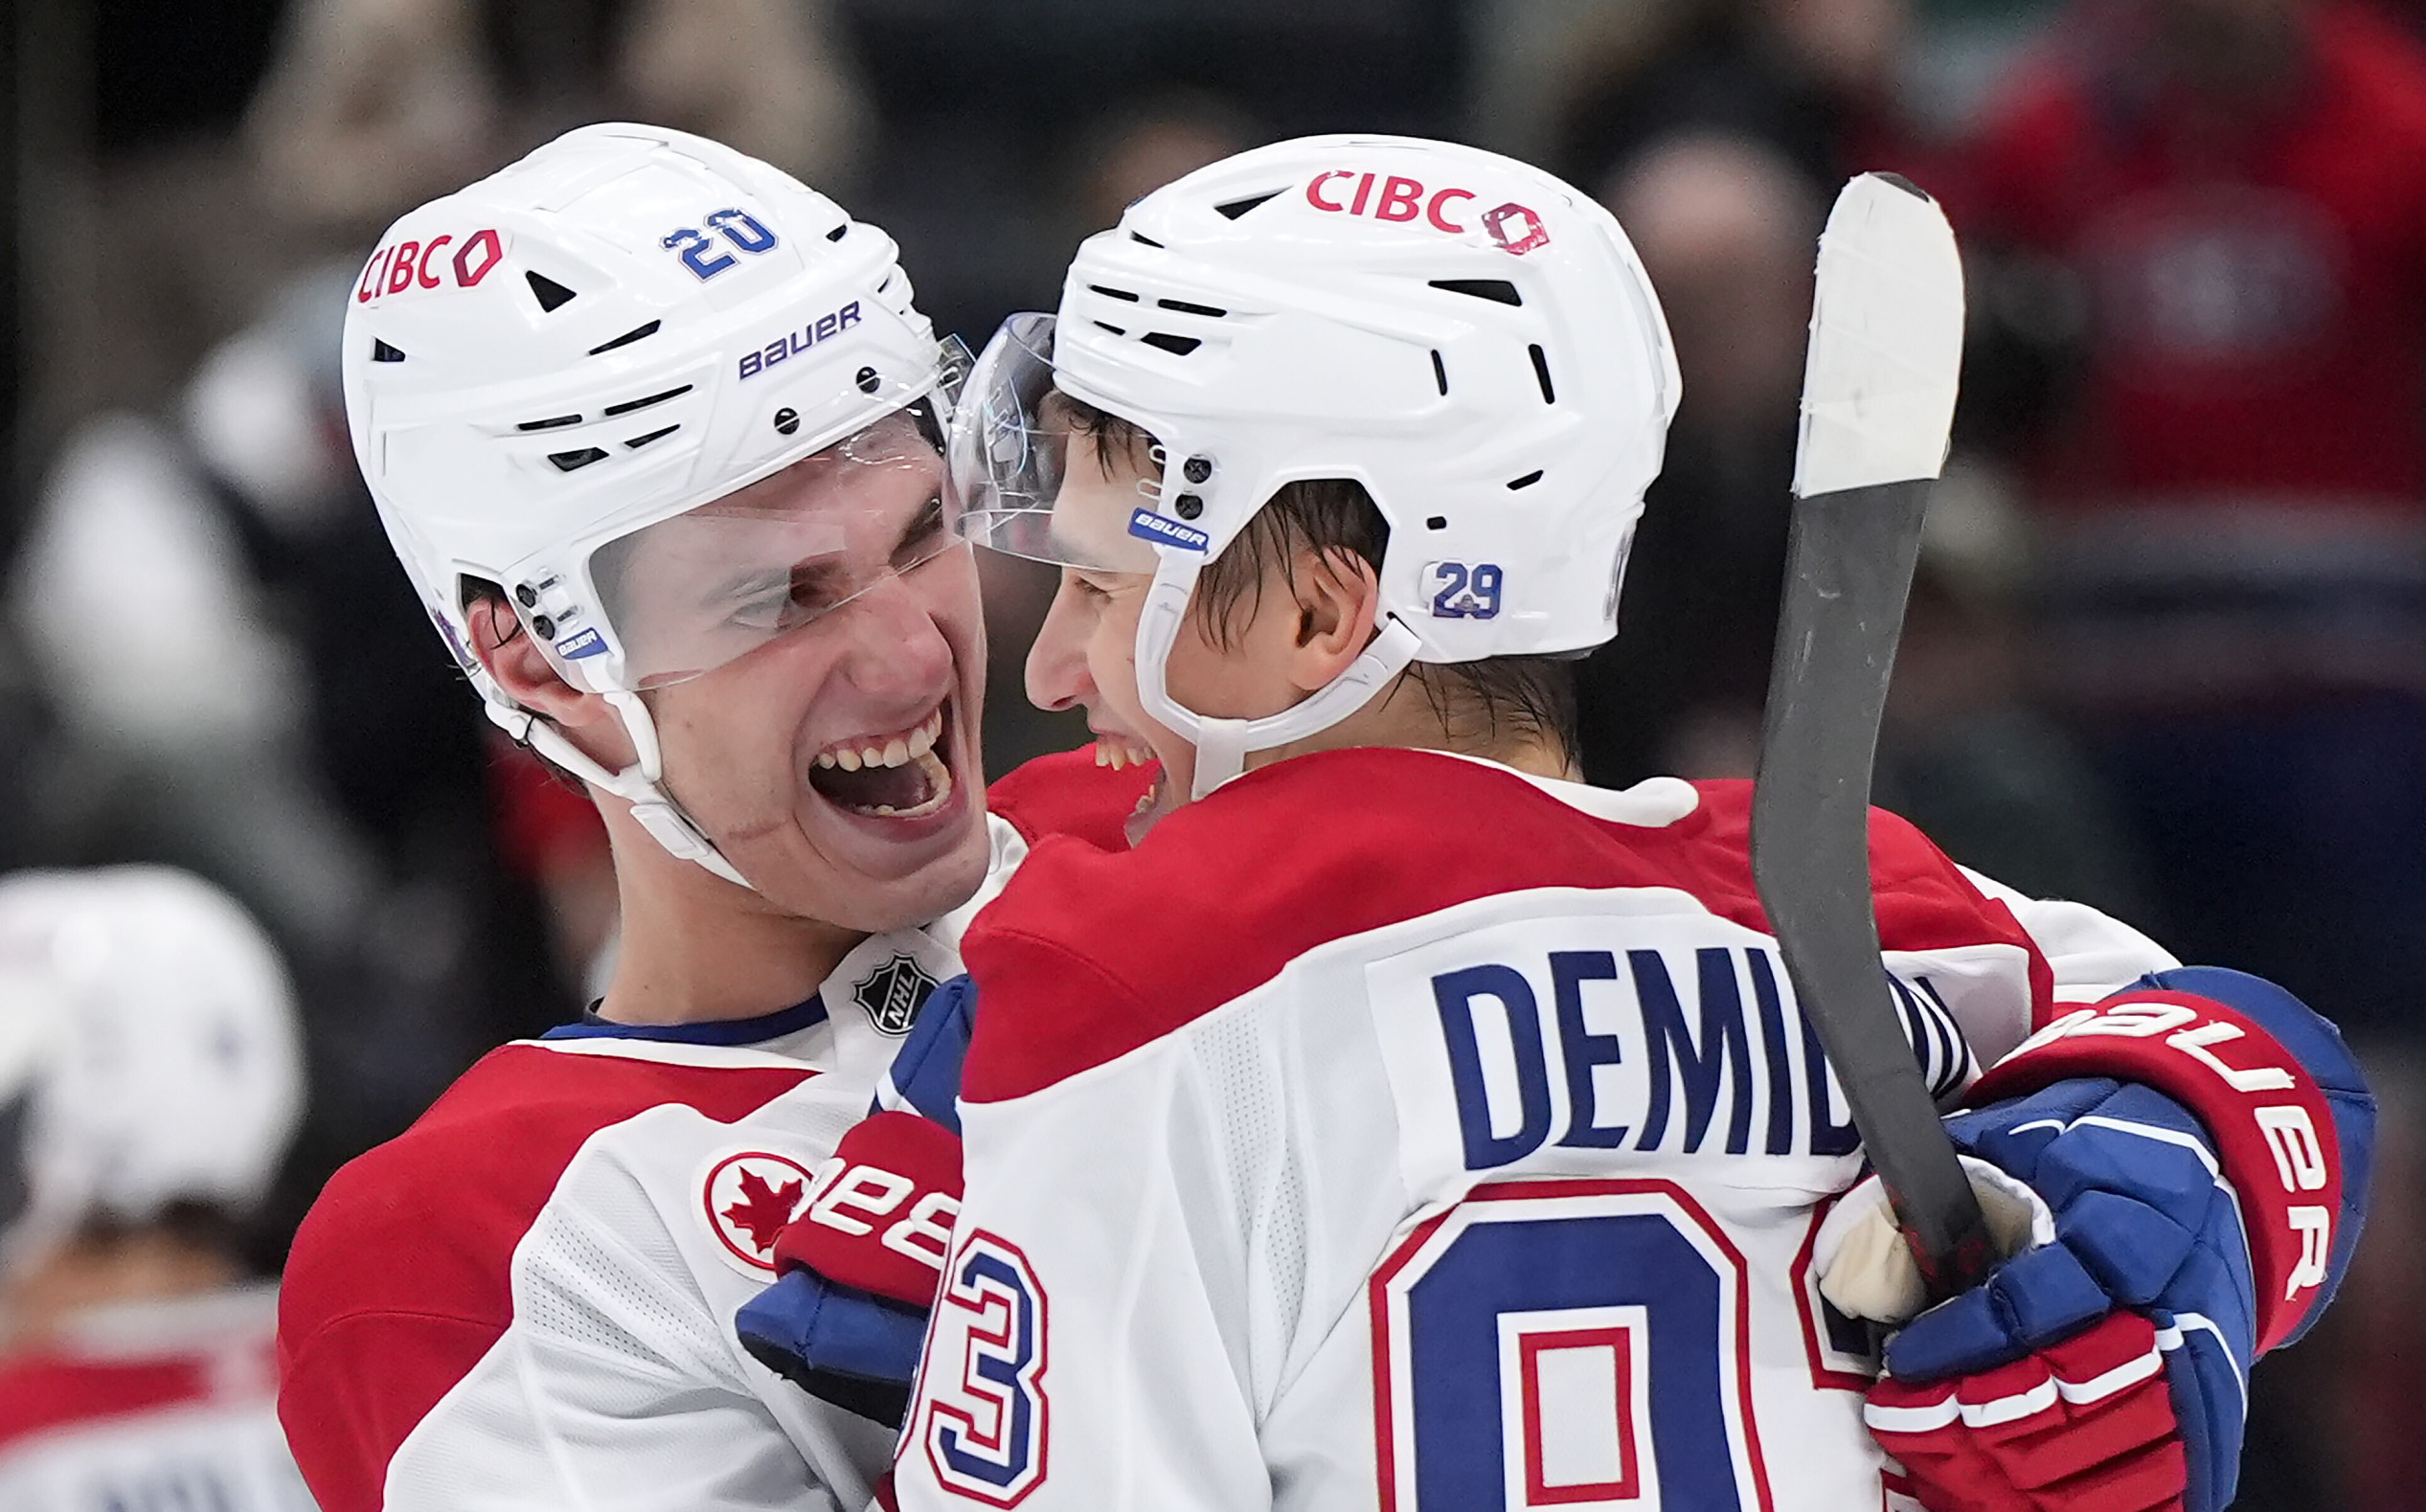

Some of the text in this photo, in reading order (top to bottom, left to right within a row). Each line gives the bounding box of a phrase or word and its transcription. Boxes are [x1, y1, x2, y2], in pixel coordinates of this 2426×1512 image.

[1305, 170, 1477, 235] CIBC
[357, 235, 452, 305] CIBC
[659, 207, 779, 282] 20
[1433, 562, 1504, 621] 29
[887, 974, 915, 1027] NHL
